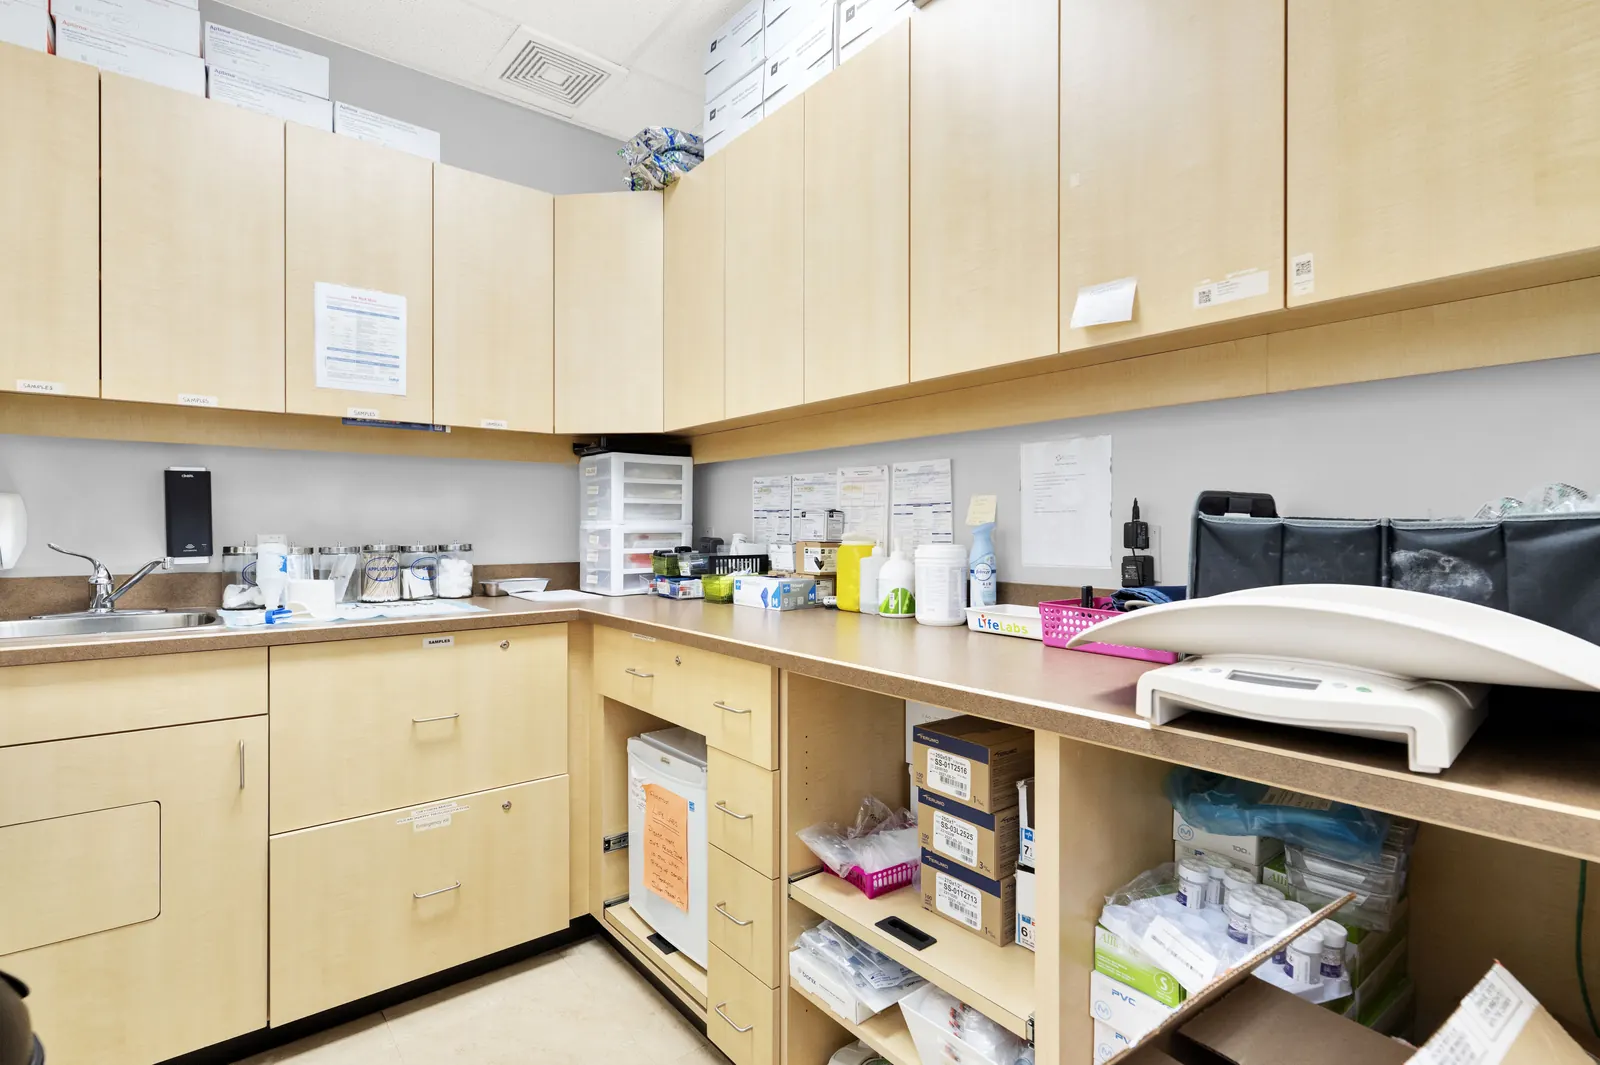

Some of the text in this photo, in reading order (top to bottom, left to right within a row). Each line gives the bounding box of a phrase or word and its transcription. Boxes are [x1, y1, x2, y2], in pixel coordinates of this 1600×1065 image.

[182, 396, 210, 404] SAMPLES
[978, 614, 1028, 634] LifeLabs
[934, 758, 968, 774] SS-01T2516
[940, 821, 974, 840] SS-03L2525
[1232, 844, 1248, 854] 100
[944, 883, 978, 904] SS-01T2713
[1160, 976, 1168, 991] S
[1112, 988, 1136, 1007] PVC
